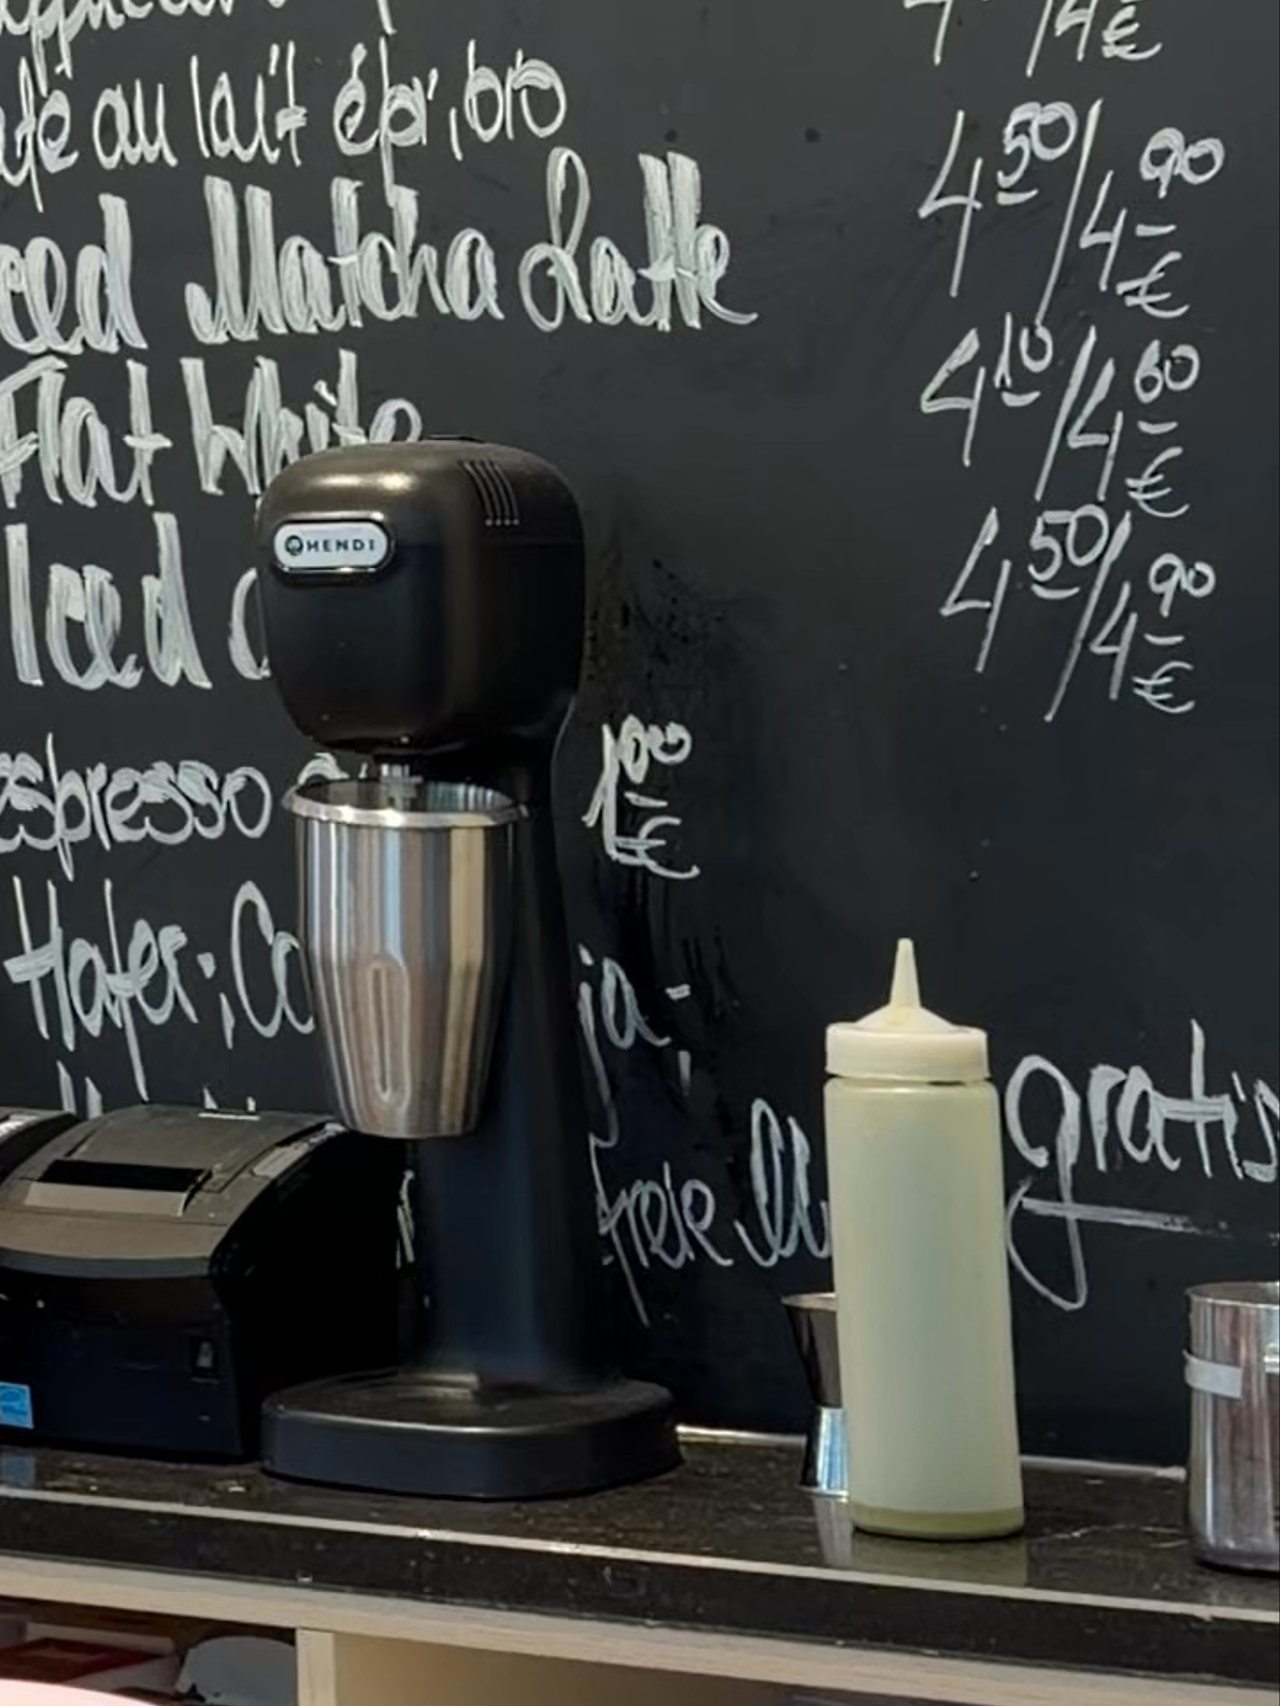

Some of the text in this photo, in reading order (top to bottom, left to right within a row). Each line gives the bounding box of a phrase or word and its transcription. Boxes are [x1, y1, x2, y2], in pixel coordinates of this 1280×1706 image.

[93, 78, 179, 171] au
[185, 176, 505, 346] Matcha
[517, 146, 759, 332] Latte
[4, 511, 213, 691] Iced
[306, 538, 376, 553] HENDI
